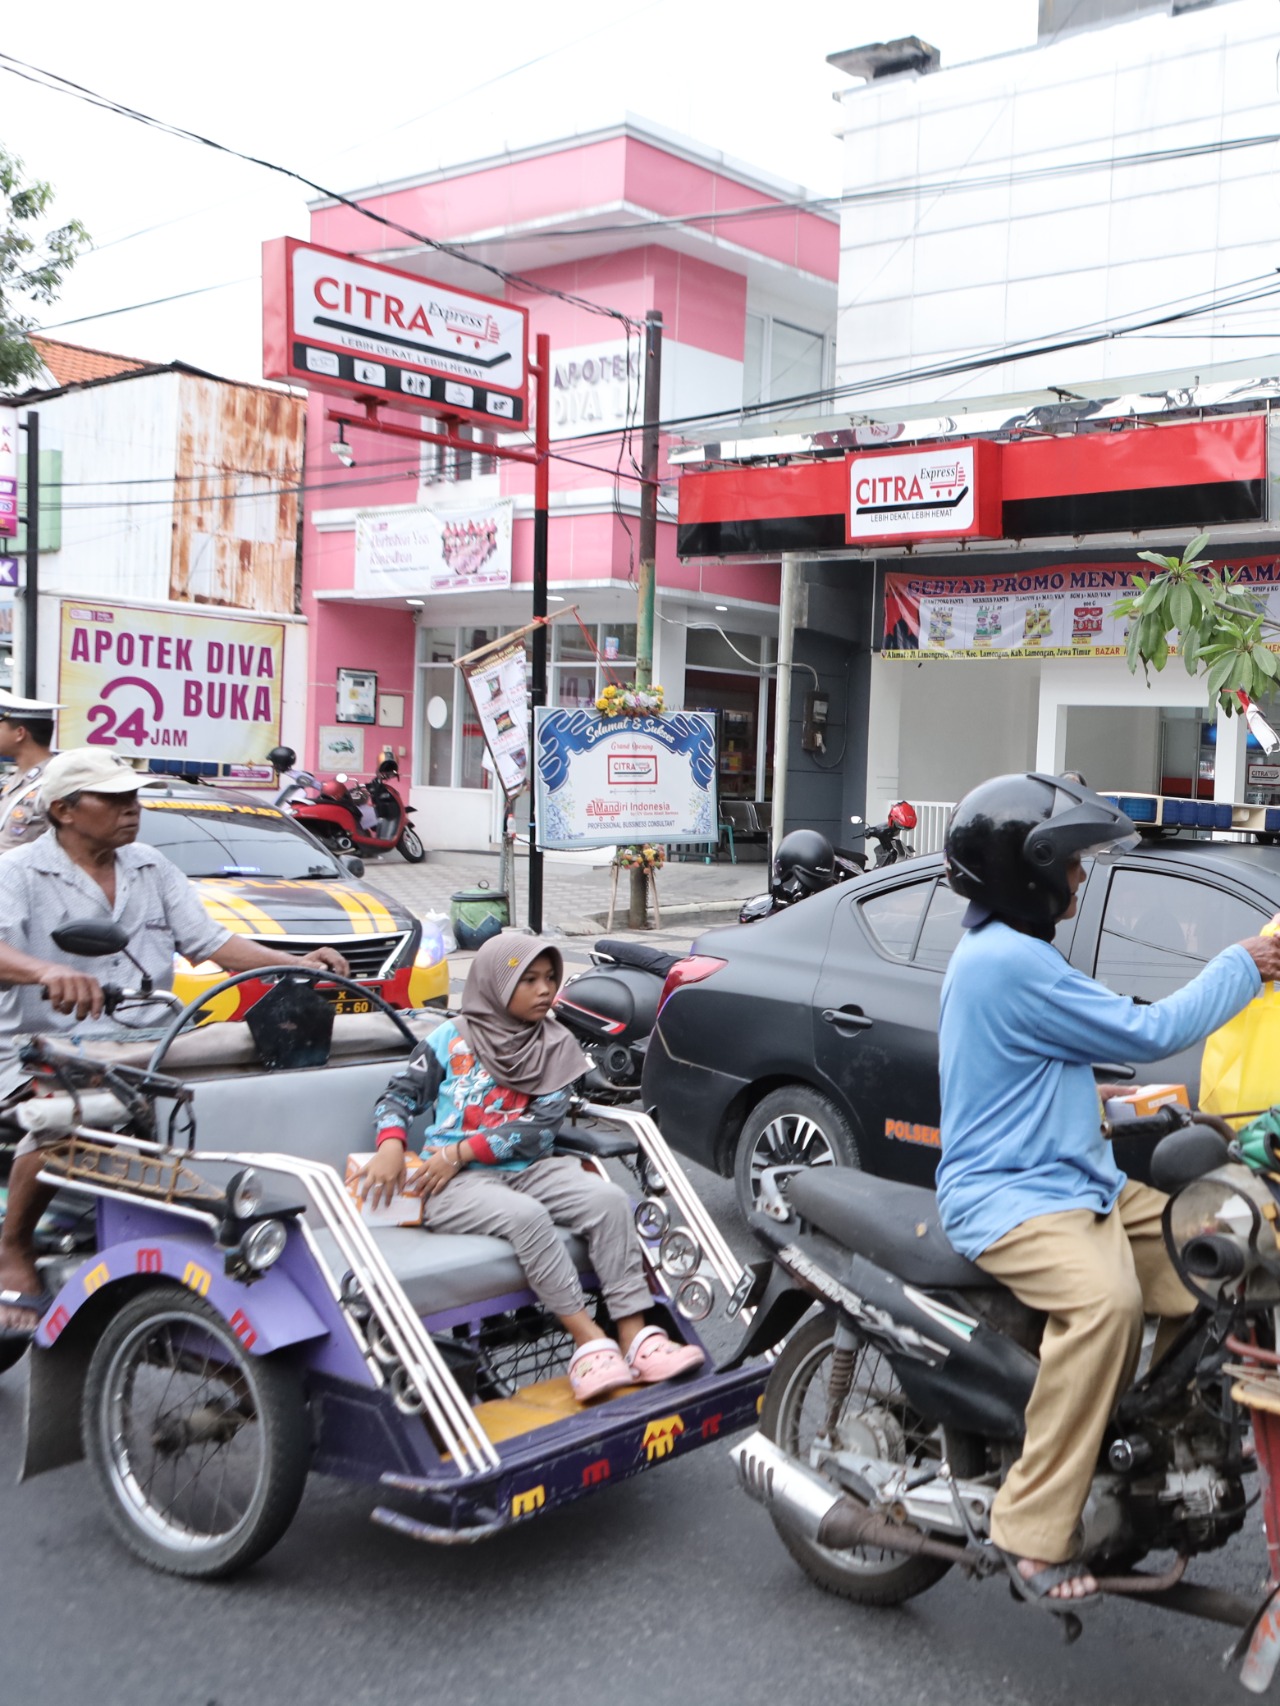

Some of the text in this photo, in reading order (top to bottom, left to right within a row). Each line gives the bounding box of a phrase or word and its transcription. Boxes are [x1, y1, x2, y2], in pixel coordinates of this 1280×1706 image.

[313, 277, 434, 337] CITRA
[428, 302, 484, 329] Express
[920, 466, 955, 481] Express
[855, 474, 924, 505] CITRA
[870, 513, 889, 523] LEBIH
[911, 509, 931, 519] LEBIH
[931, 508, 953, 518] HEMAT
[907, 578, 986, 596] GEBYAR
[991, 573, 1065, 592] PROMO
[71, 628, 274, 679] APOTEK DIVA
[1072, 647, 1091, 656] Timur
[1095, 647, 1120, 655] BAZAR
[183, 679, 272, 722] BUKA
[86, 704, 188, 747] 24 JAM
[586, 717, 632, 743] Selamat
[643, 718, 675, 744] Sukses
[613, 762, 636, 771] CITRA
[596, 802, 671, 813] Mandiri Indonesia
[587, 822, 621, 830] PROFESSIONAL
[647, 820, 675, 828] CONSULTANT
[353, 1002, 368, 1013] 60
[885, 1118, 941, 1149] POLSEK
